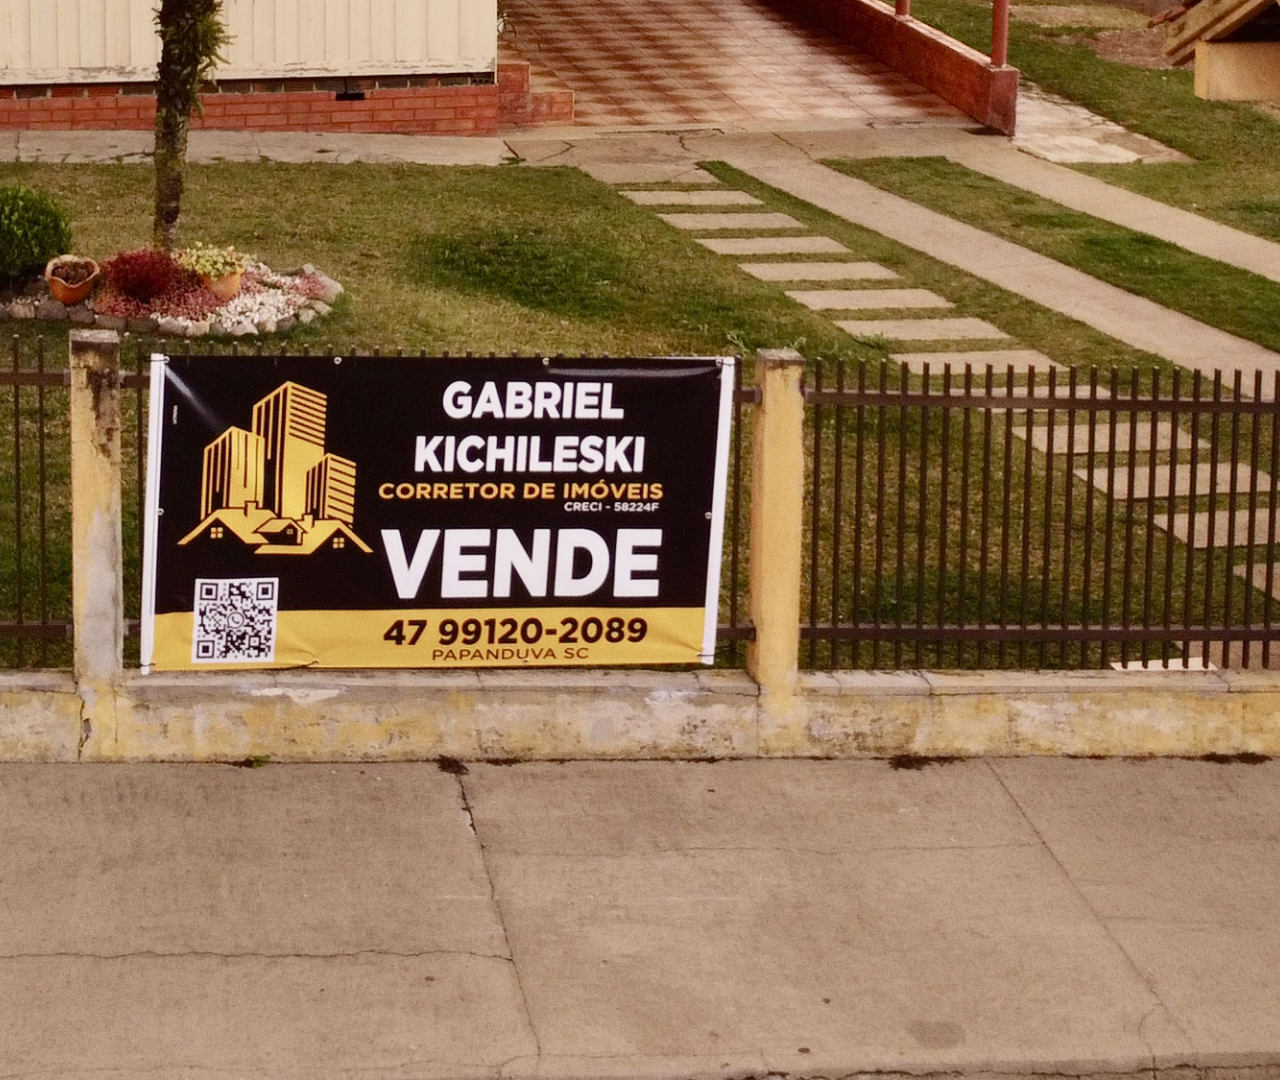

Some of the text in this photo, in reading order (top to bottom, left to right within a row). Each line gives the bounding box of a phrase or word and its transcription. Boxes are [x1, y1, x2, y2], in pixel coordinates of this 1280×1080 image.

[442, 380, 624, 419] GABRIEL
[414, 435, 645, 473] KICHILESKI
[378, 479, 663, 500] CORRETOR DE IMÓVEIS
[564, 502, 602, 512] CRECI
[614, 502, 659, 512] 58224F
[380, 528, 663, 599] VENDE
[383, 617, 648, 645] 47 99120-2089
[432, 647, 589, 661] PAPANDUVA SC
